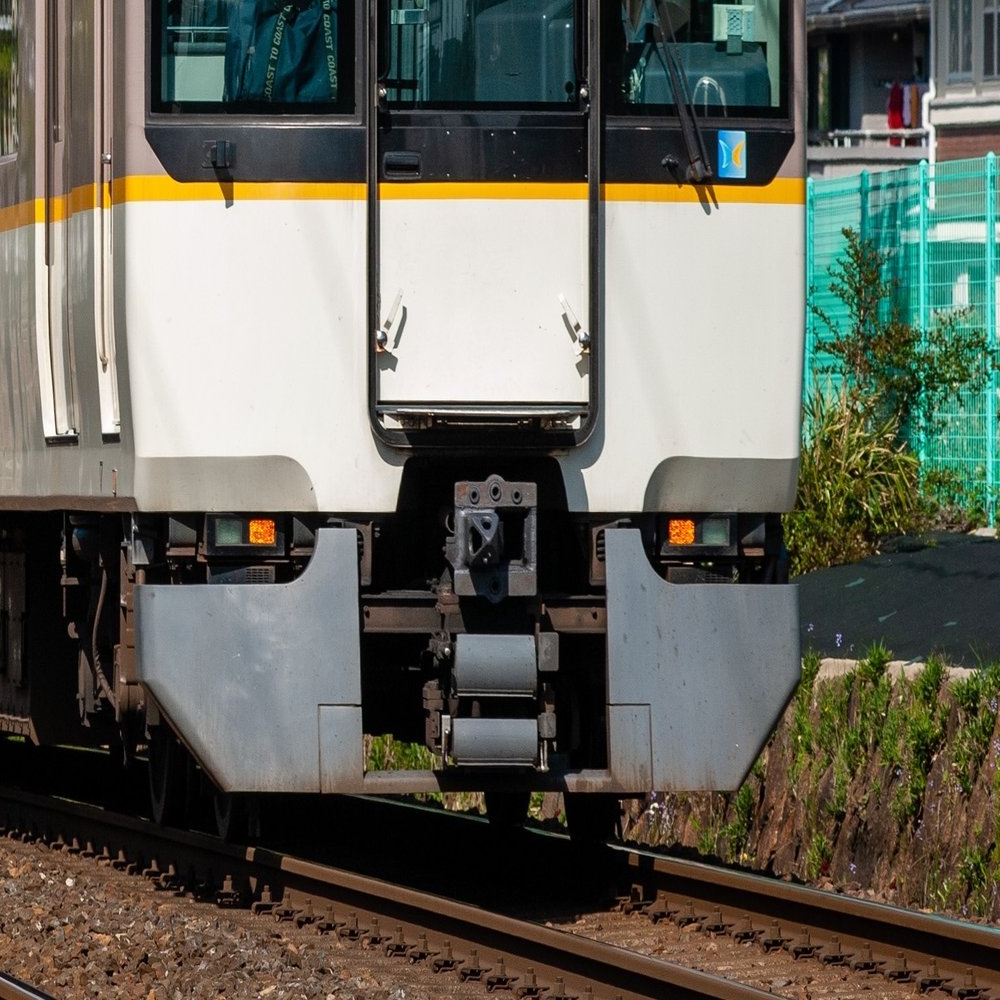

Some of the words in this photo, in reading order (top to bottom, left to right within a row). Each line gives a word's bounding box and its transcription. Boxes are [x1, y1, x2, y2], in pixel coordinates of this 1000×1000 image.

[273, 12, 287, 46] COAST
[323, 13, 334, 51] COAST
[269, 47, 280, 61] TO
[326, 55, 338, 89] COAST
